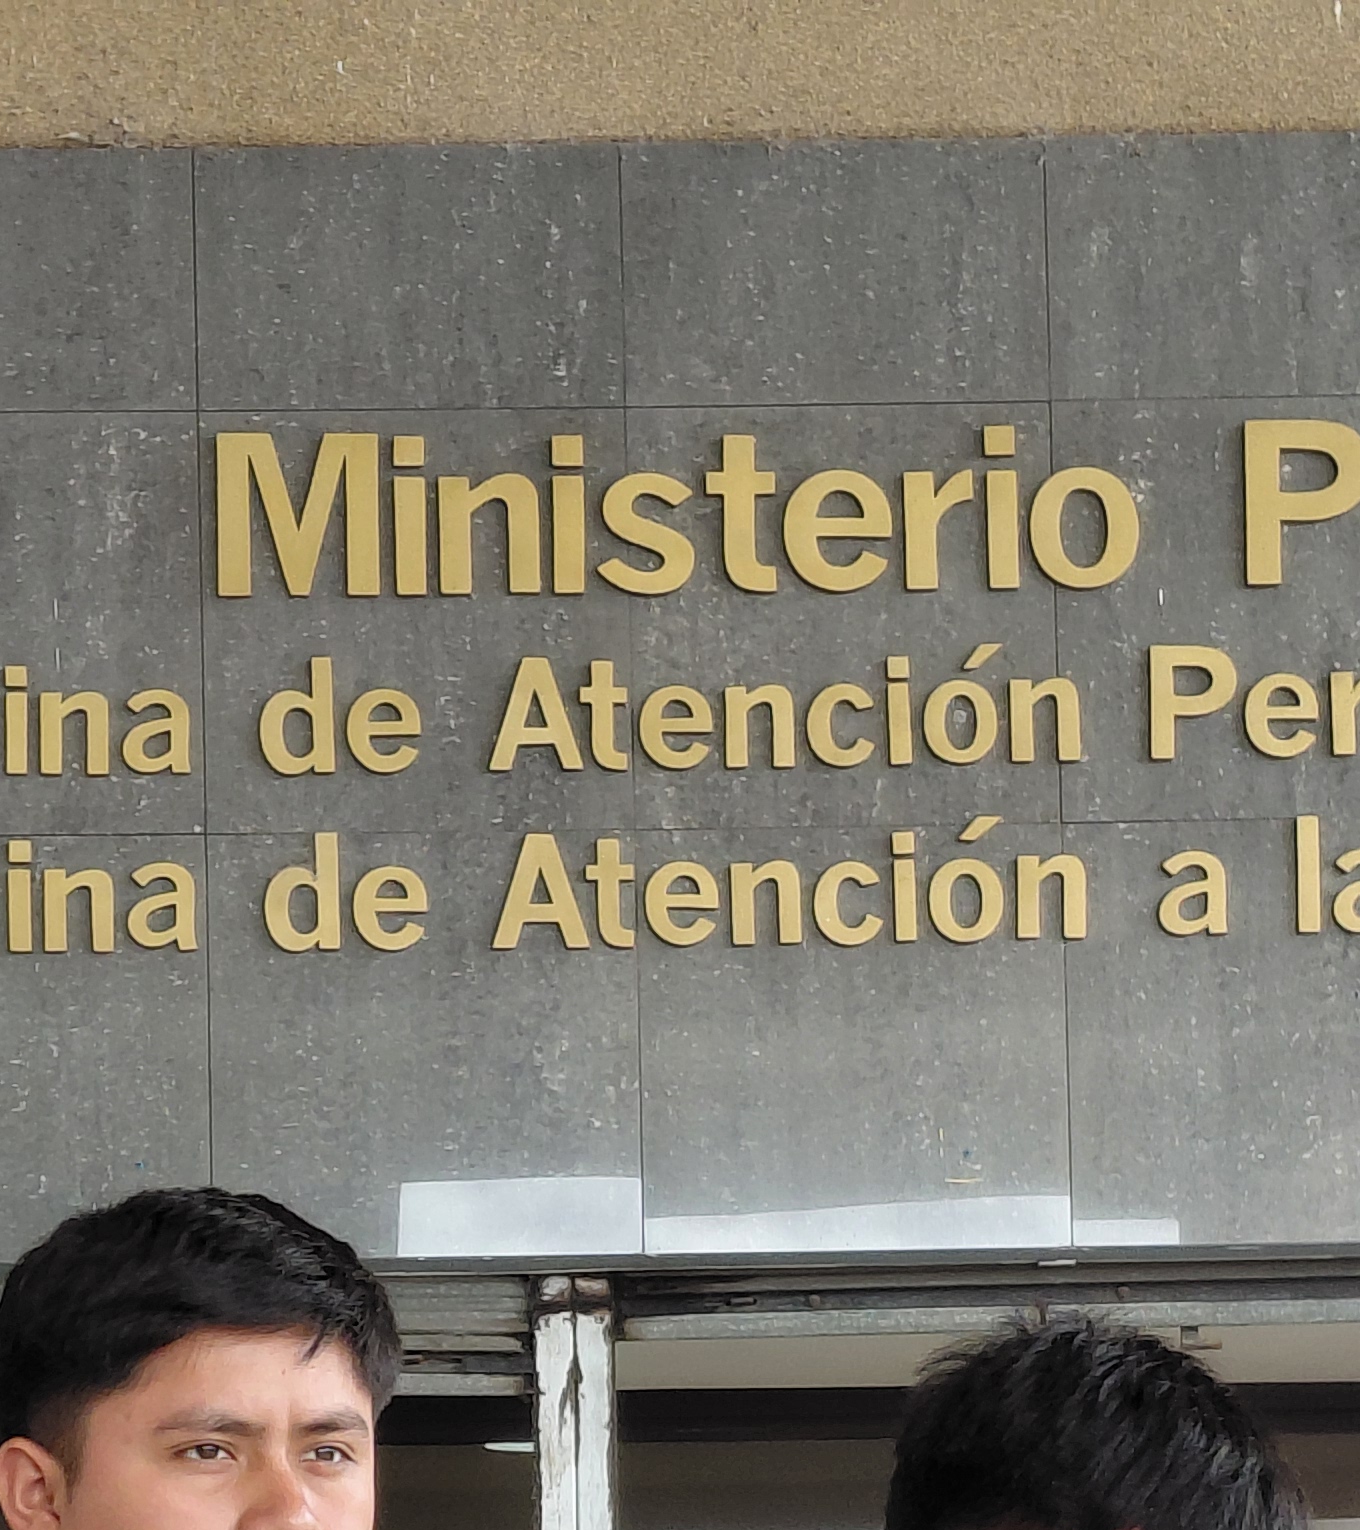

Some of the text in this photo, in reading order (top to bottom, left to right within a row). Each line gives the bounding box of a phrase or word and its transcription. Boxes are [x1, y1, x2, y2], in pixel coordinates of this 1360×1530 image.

[214, 423, 1143, 598] Ministerio
[258, 655, 424, 775] de
[488, 641, 1084, 772] Atención
[263, 831, 430, 953] de
[492, 813, 1090, 950] Atención
[1157, 848, 1230, 937] a
